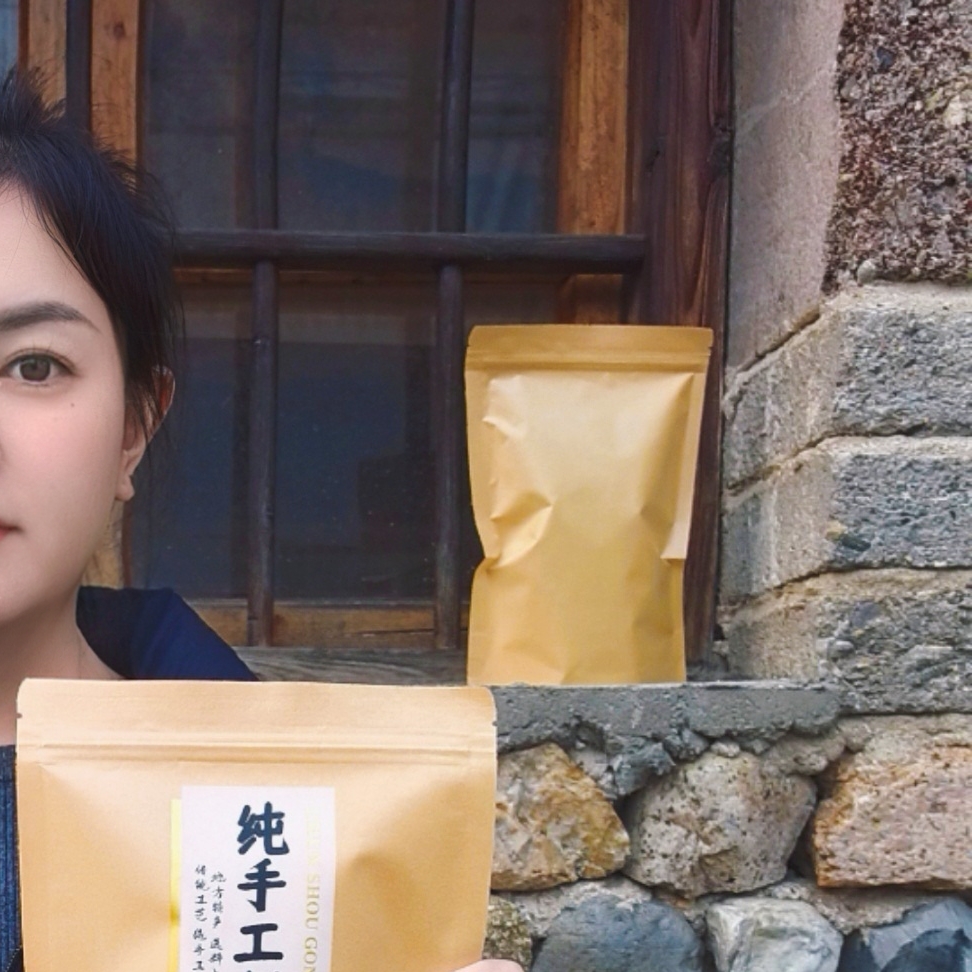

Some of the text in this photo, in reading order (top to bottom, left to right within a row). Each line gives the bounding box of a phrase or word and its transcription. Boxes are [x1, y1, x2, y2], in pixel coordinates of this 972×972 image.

[193, 864, 209, 922] 传统工艺
[303, 872, 321, 930] SHOU
